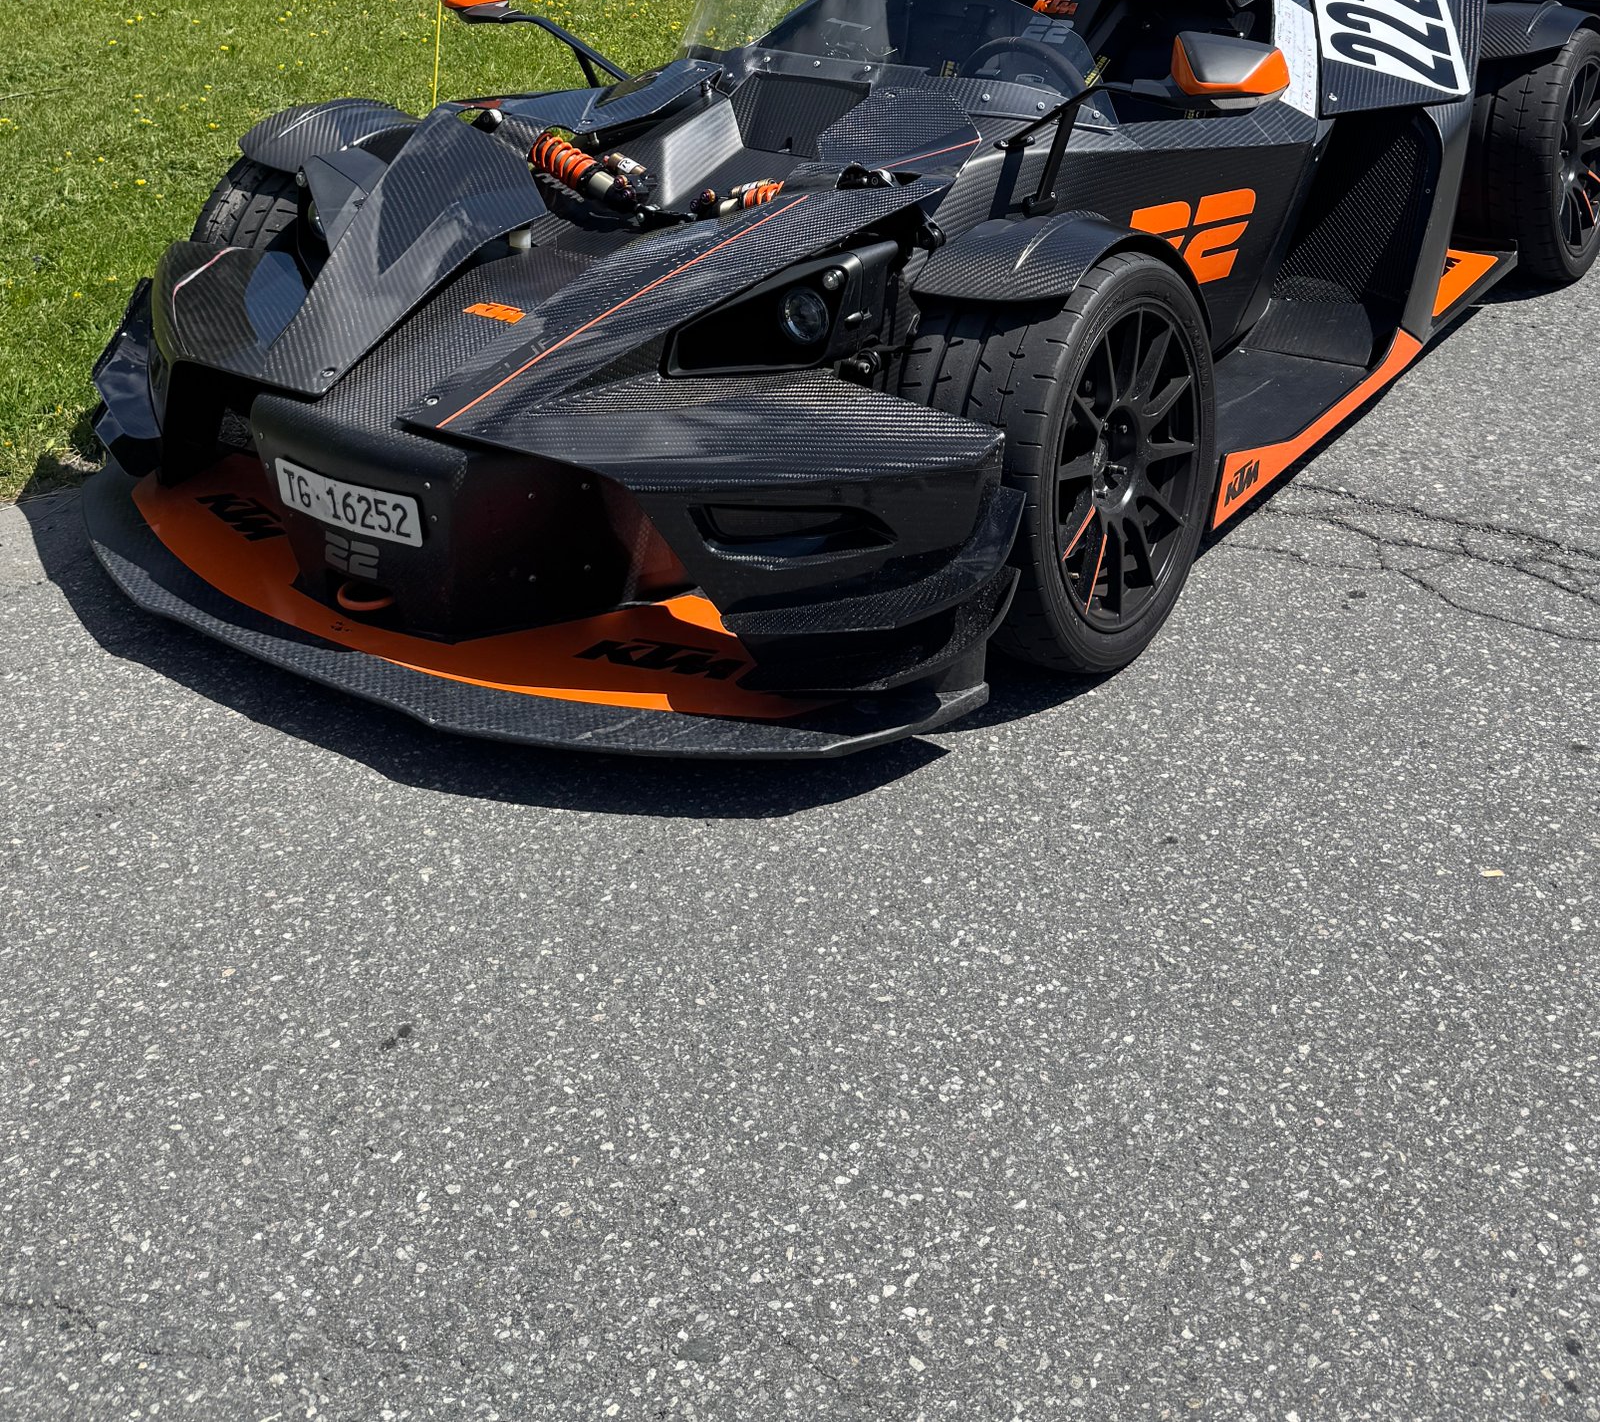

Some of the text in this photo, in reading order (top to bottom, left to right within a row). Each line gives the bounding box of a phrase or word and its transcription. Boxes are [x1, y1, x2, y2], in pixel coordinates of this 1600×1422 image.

[463, 302, 527, 324] KTM
[1223, 458, 1260, 508] KTM
[193, 493, 287, 541] KTM
[573, 638, 746, 680] KTM
